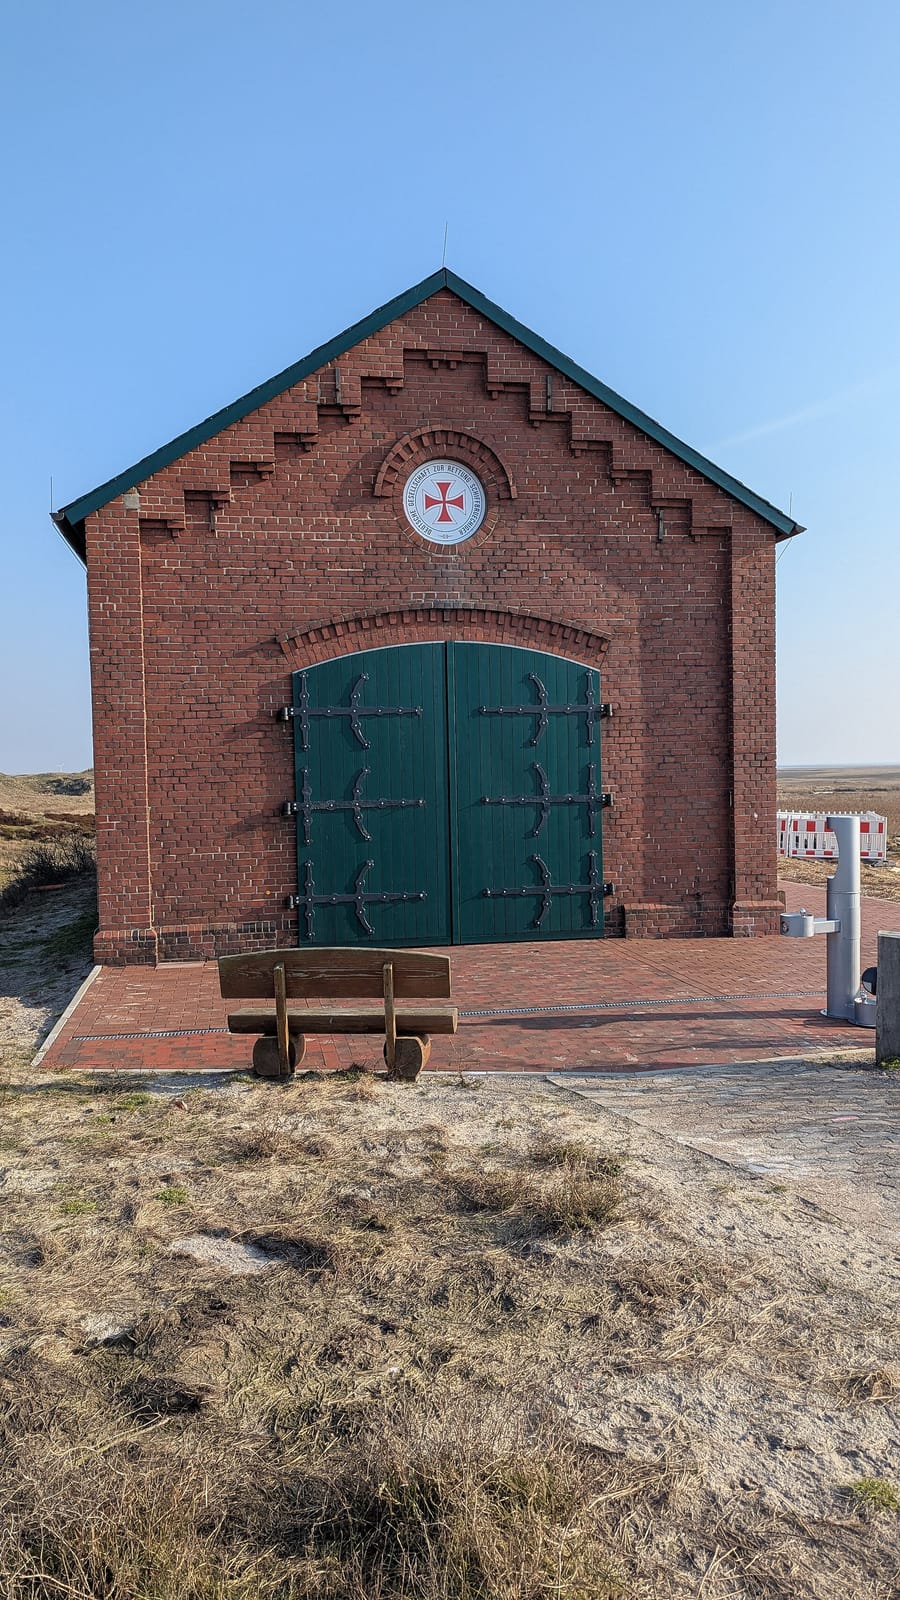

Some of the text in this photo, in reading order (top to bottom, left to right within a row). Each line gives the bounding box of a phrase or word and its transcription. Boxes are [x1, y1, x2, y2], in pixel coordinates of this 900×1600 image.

[433, 465, 444, 473] ZUR
[448, 465, 471, 482] RETTUNG
[408, 468, 430, 507] GESELLSCHAFT
[410, 510, 432, 535] DEUTSCHE
